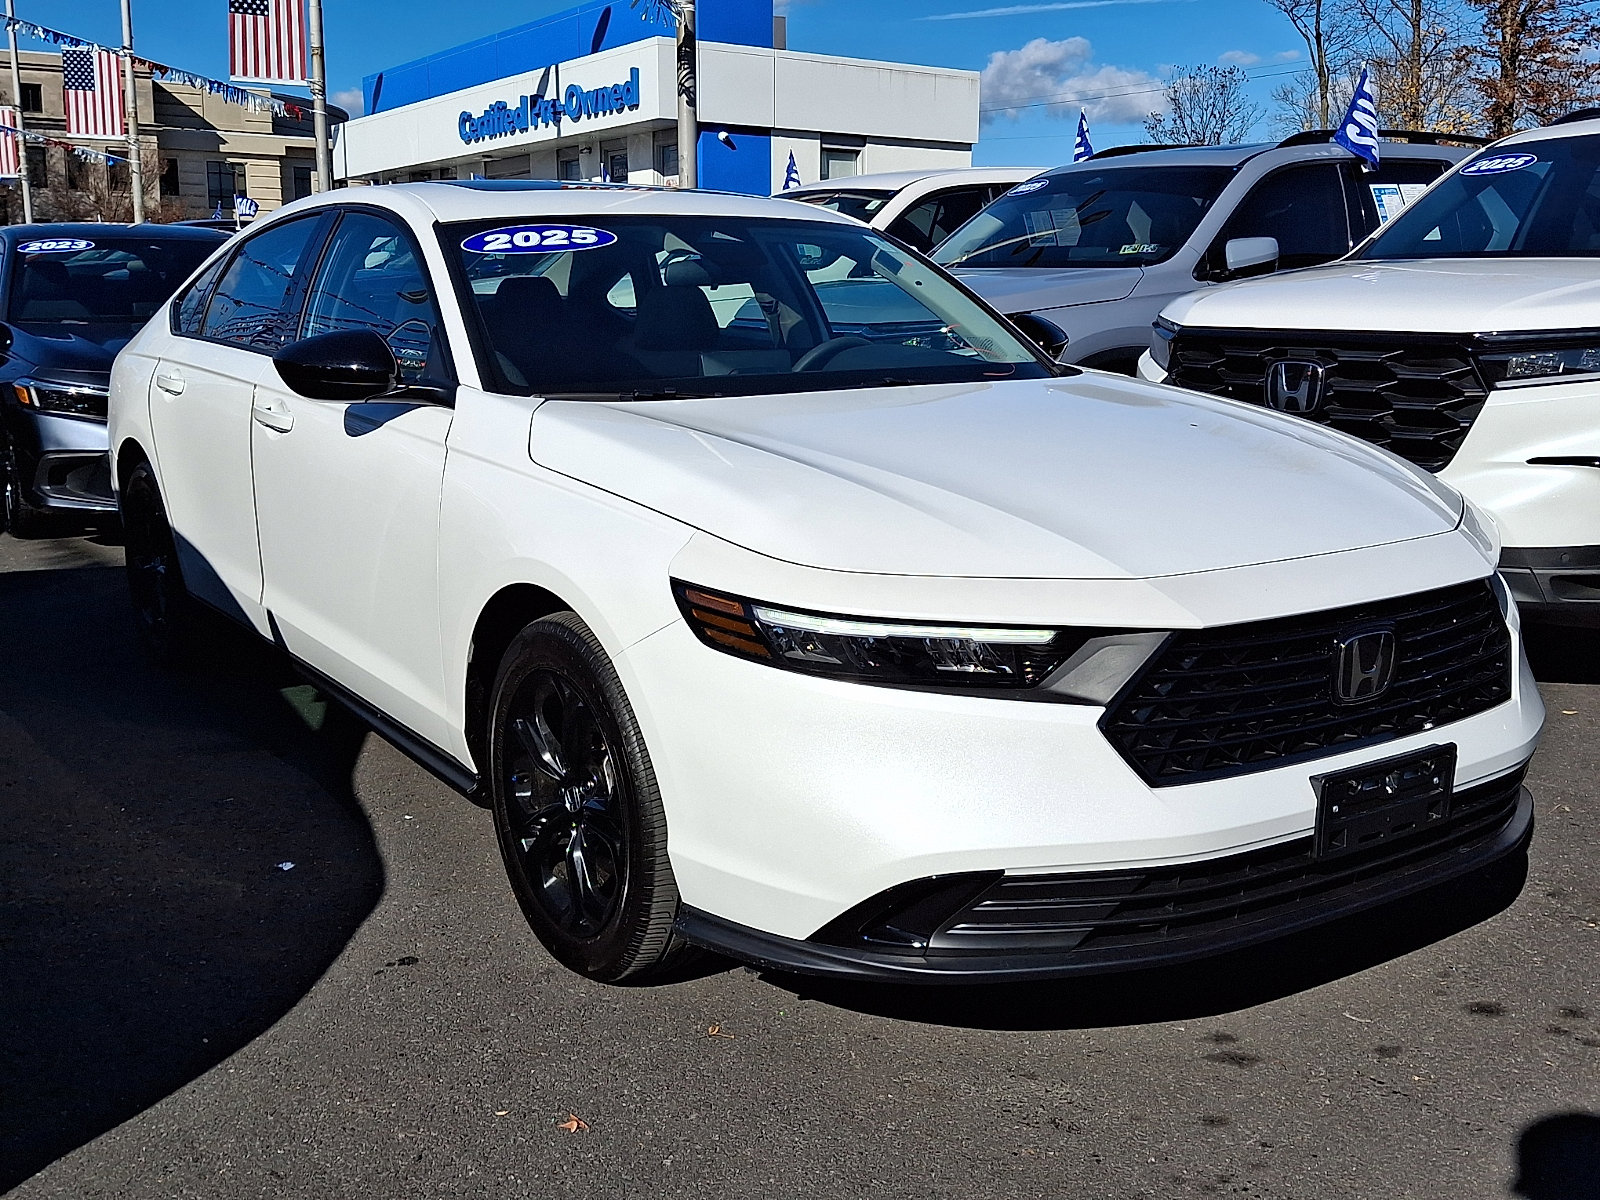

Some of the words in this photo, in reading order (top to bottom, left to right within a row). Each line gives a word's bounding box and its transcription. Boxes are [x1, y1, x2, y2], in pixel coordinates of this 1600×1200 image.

[459, 95, 529, 141] Certified
[530, 67, 640, 127] Pre-Owned
[1463, 156, 1533, 173] 2025
[237, 198, 257, 216] SALE
[25, 241, 88, 251] 2023
[482, 229, 599, 251] 2025
